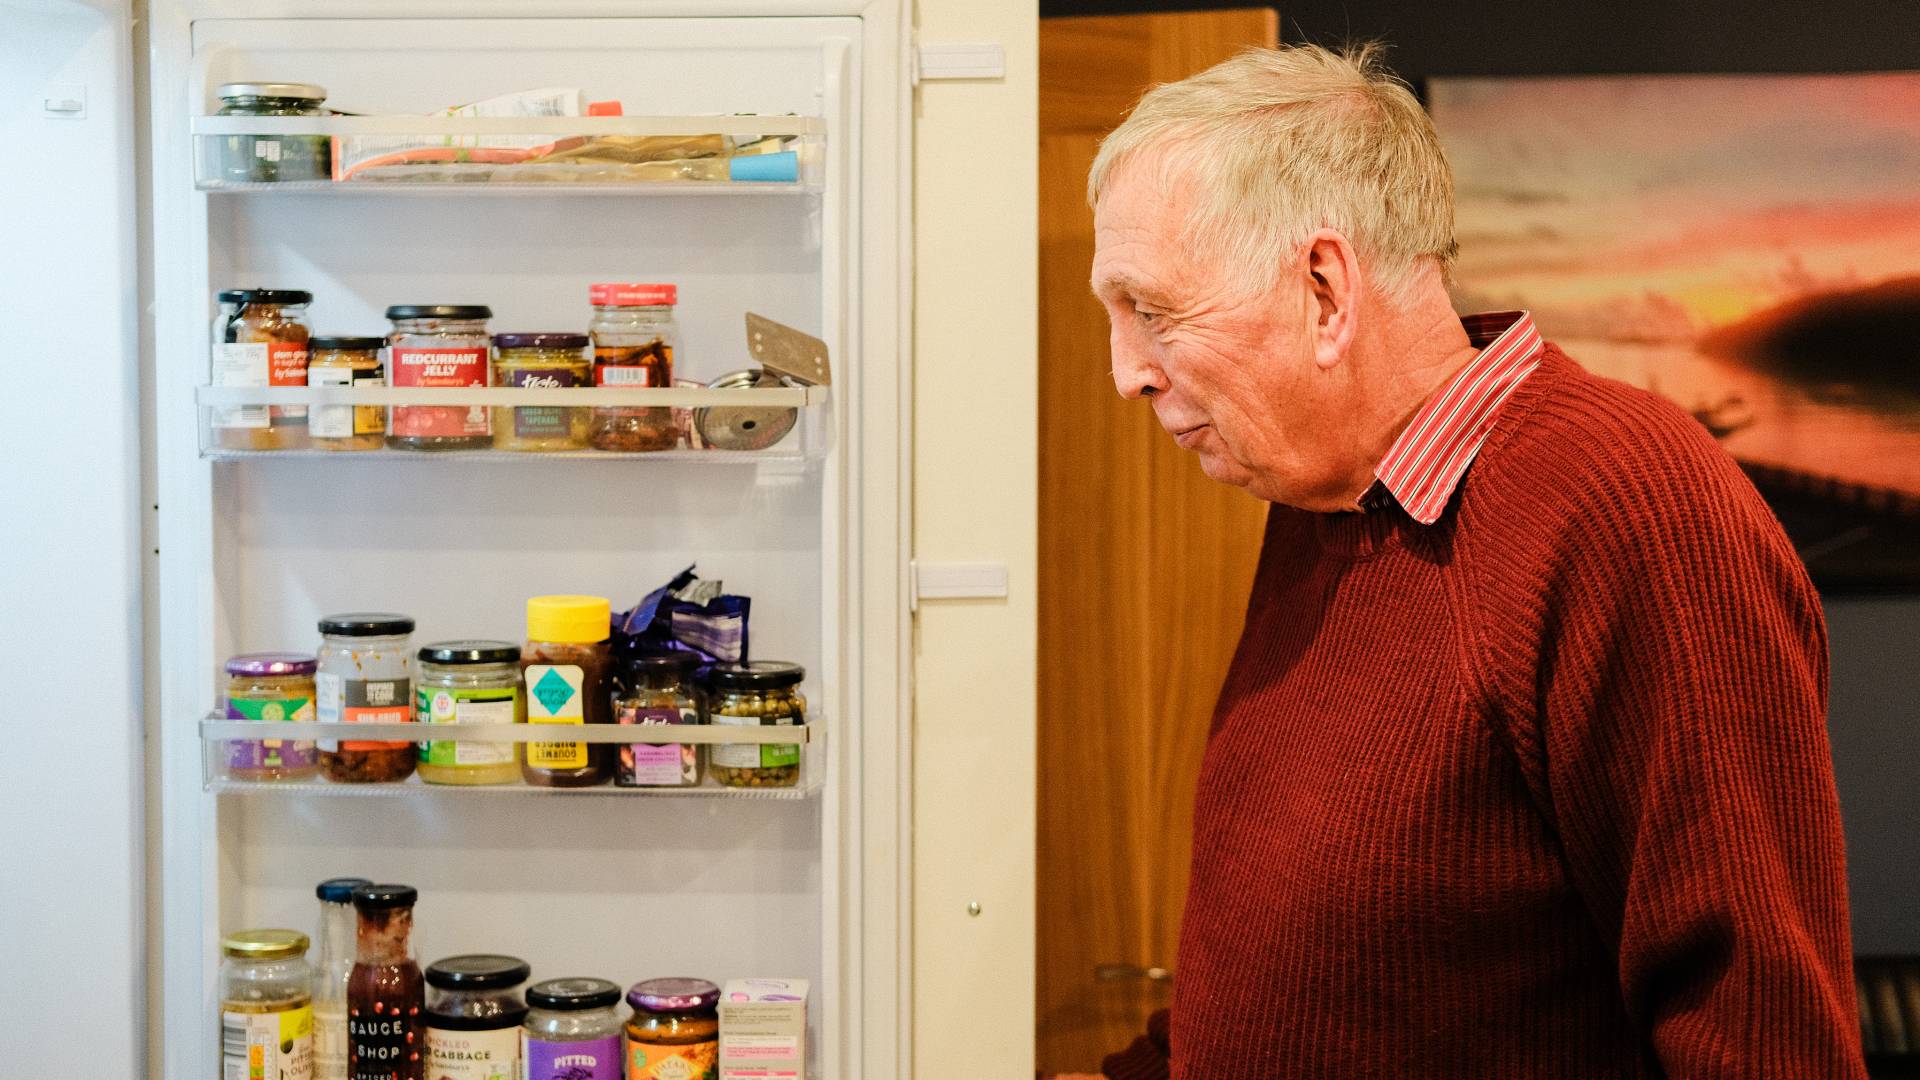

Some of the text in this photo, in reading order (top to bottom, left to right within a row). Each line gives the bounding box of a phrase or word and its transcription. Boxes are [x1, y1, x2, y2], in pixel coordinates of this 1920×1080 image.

[401, 353, 478, 364] REDCURRANT
[423, 365, 457, 376] JELLY
[536, 750, 577, 758] GOURMET
[350, 1020, 403, 1036] SAUCE
[358, 1044, 400, 1060] SHOP
[433, 1049, 491, 1061] CABBAGE
[554, 1054, 597, 1069] PITTED
